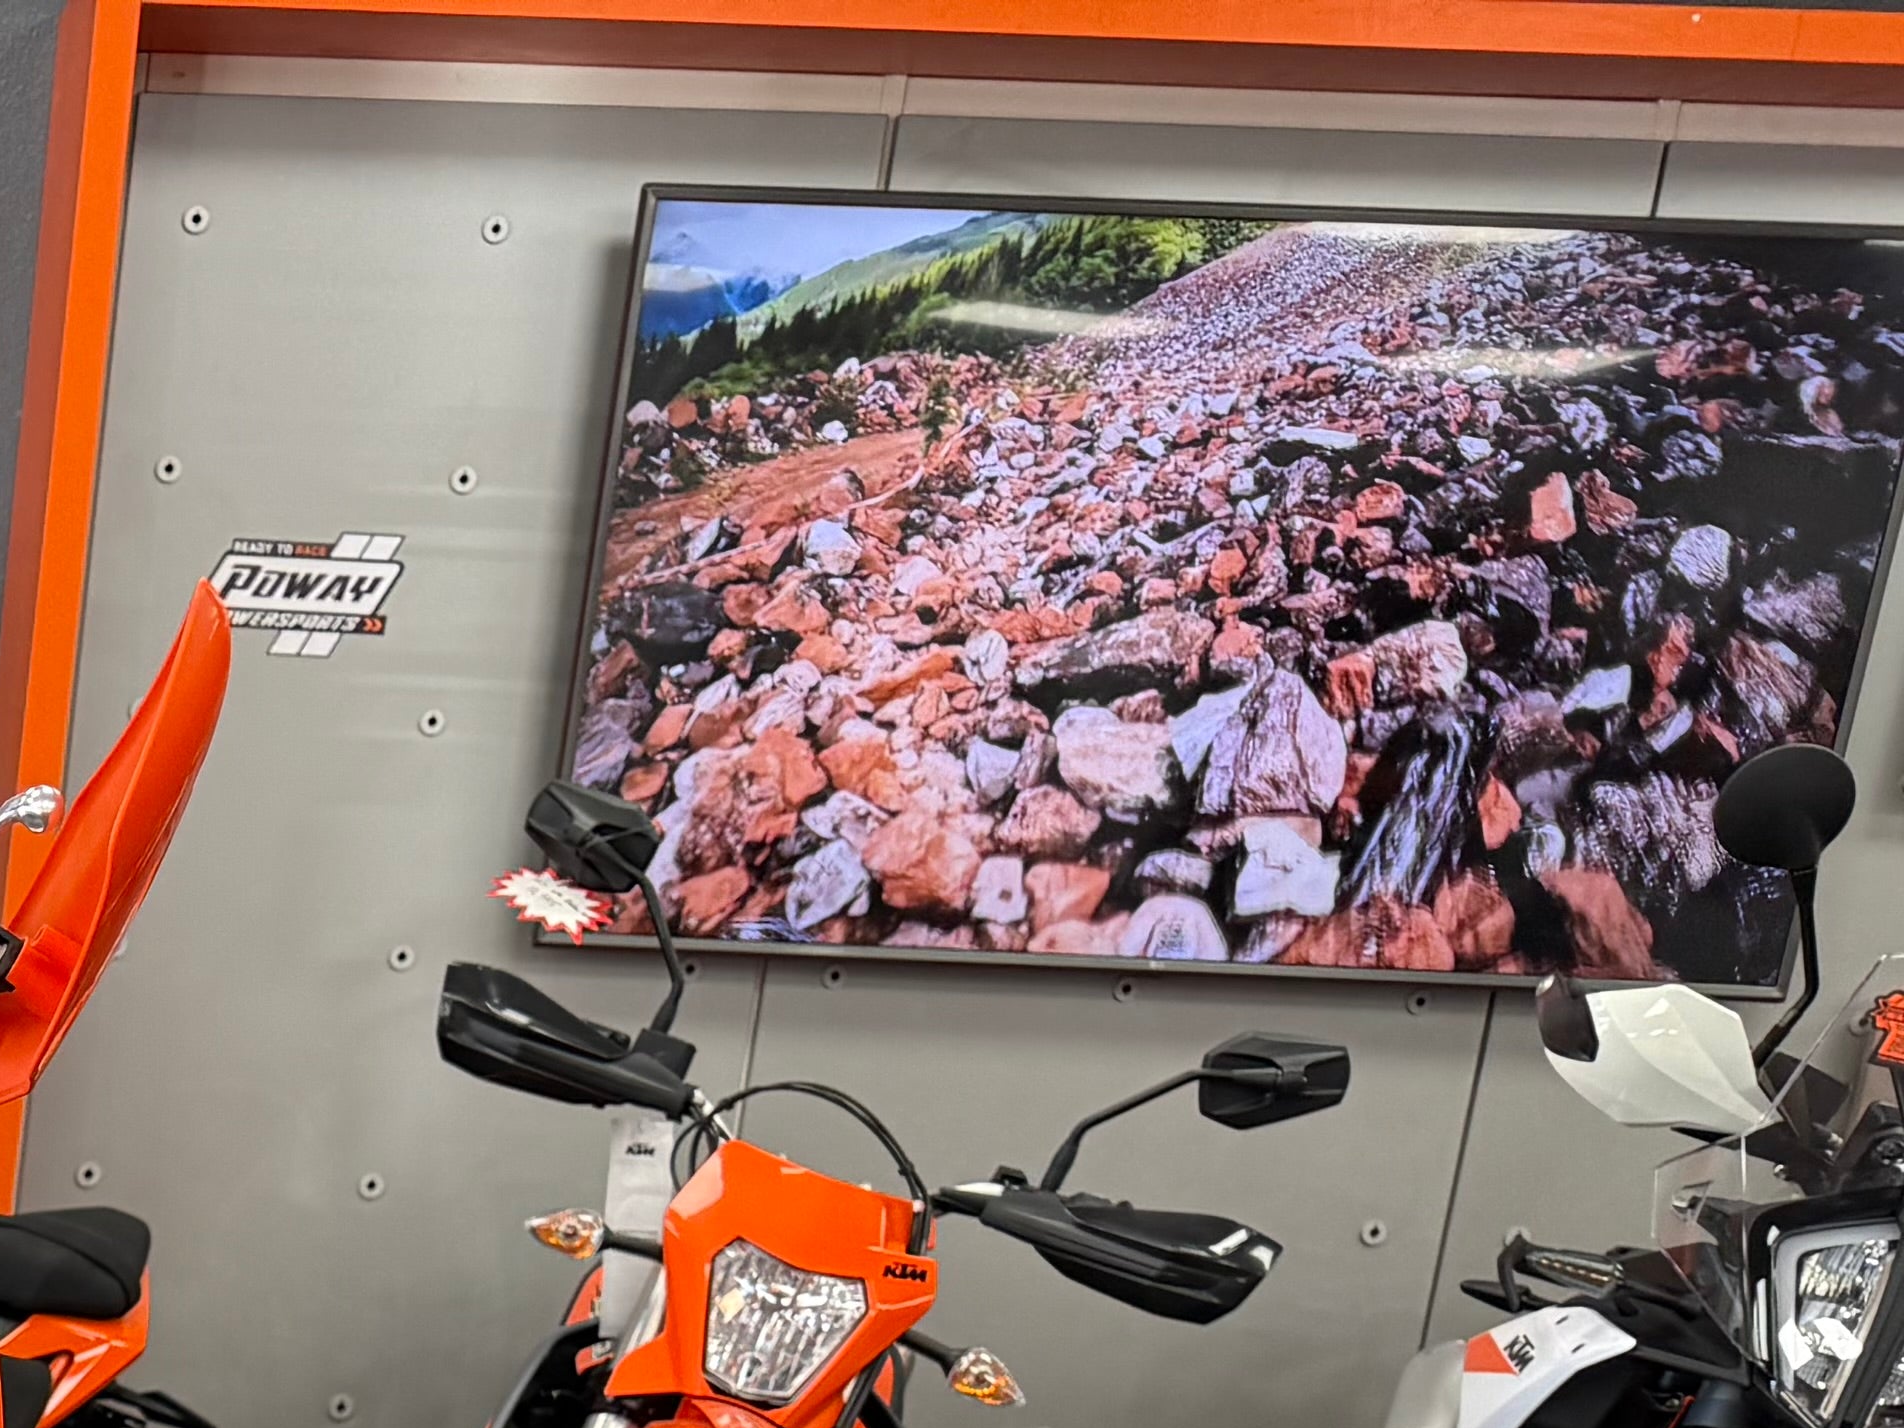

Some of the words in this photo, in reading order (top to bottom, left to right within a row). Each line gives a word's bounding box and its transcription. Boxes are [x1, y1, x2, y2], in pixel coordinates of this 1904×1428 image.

[220, 564, 384, 602] POWAY
[229, 610, 361, 632] WERSPORTS
[625, 1140, 656, 1157] KTM
[883, 1261, 929, 1284] KTM
[1503, 1332, 1537, 1377] KTM
